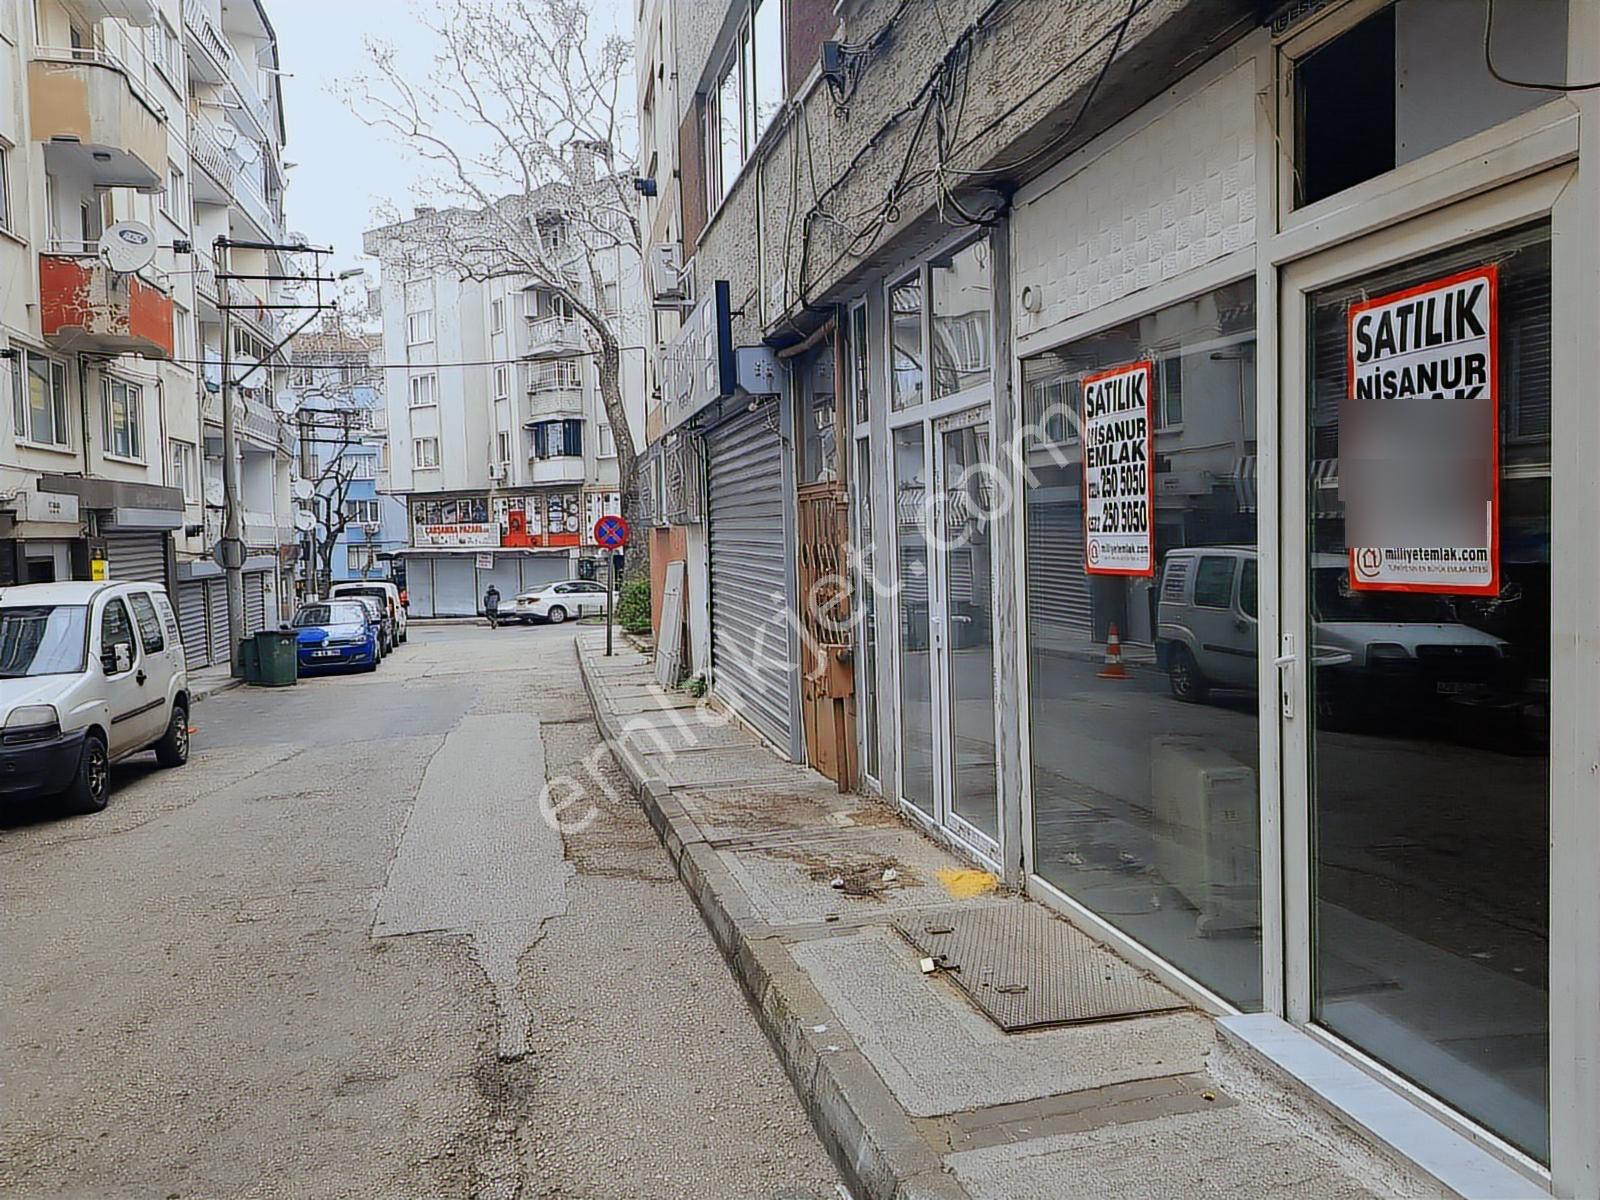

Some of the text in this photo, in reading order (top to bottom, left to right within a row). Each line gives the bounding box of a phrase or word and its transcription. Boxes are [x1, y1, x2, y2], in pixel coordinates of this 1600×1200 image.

[1357, 284, 1486, 362] SATILIK
[1356, 353, 1487, 400] NİSANUR
[1086, 373, 1146, 418] SATILIK
[1086, 417, 1147, 448] NİSANUR
[1086, 440, 1147, 468] EMLAK
[1101, 466, 1118, 498] 250
[1119, 463, 1147, 497] 5050
[1102, 501, 1119, 533] 250
[1120, 500, 1148, 533] 5050
[1385, 547, 1488, 564] milliyetemlak.com
